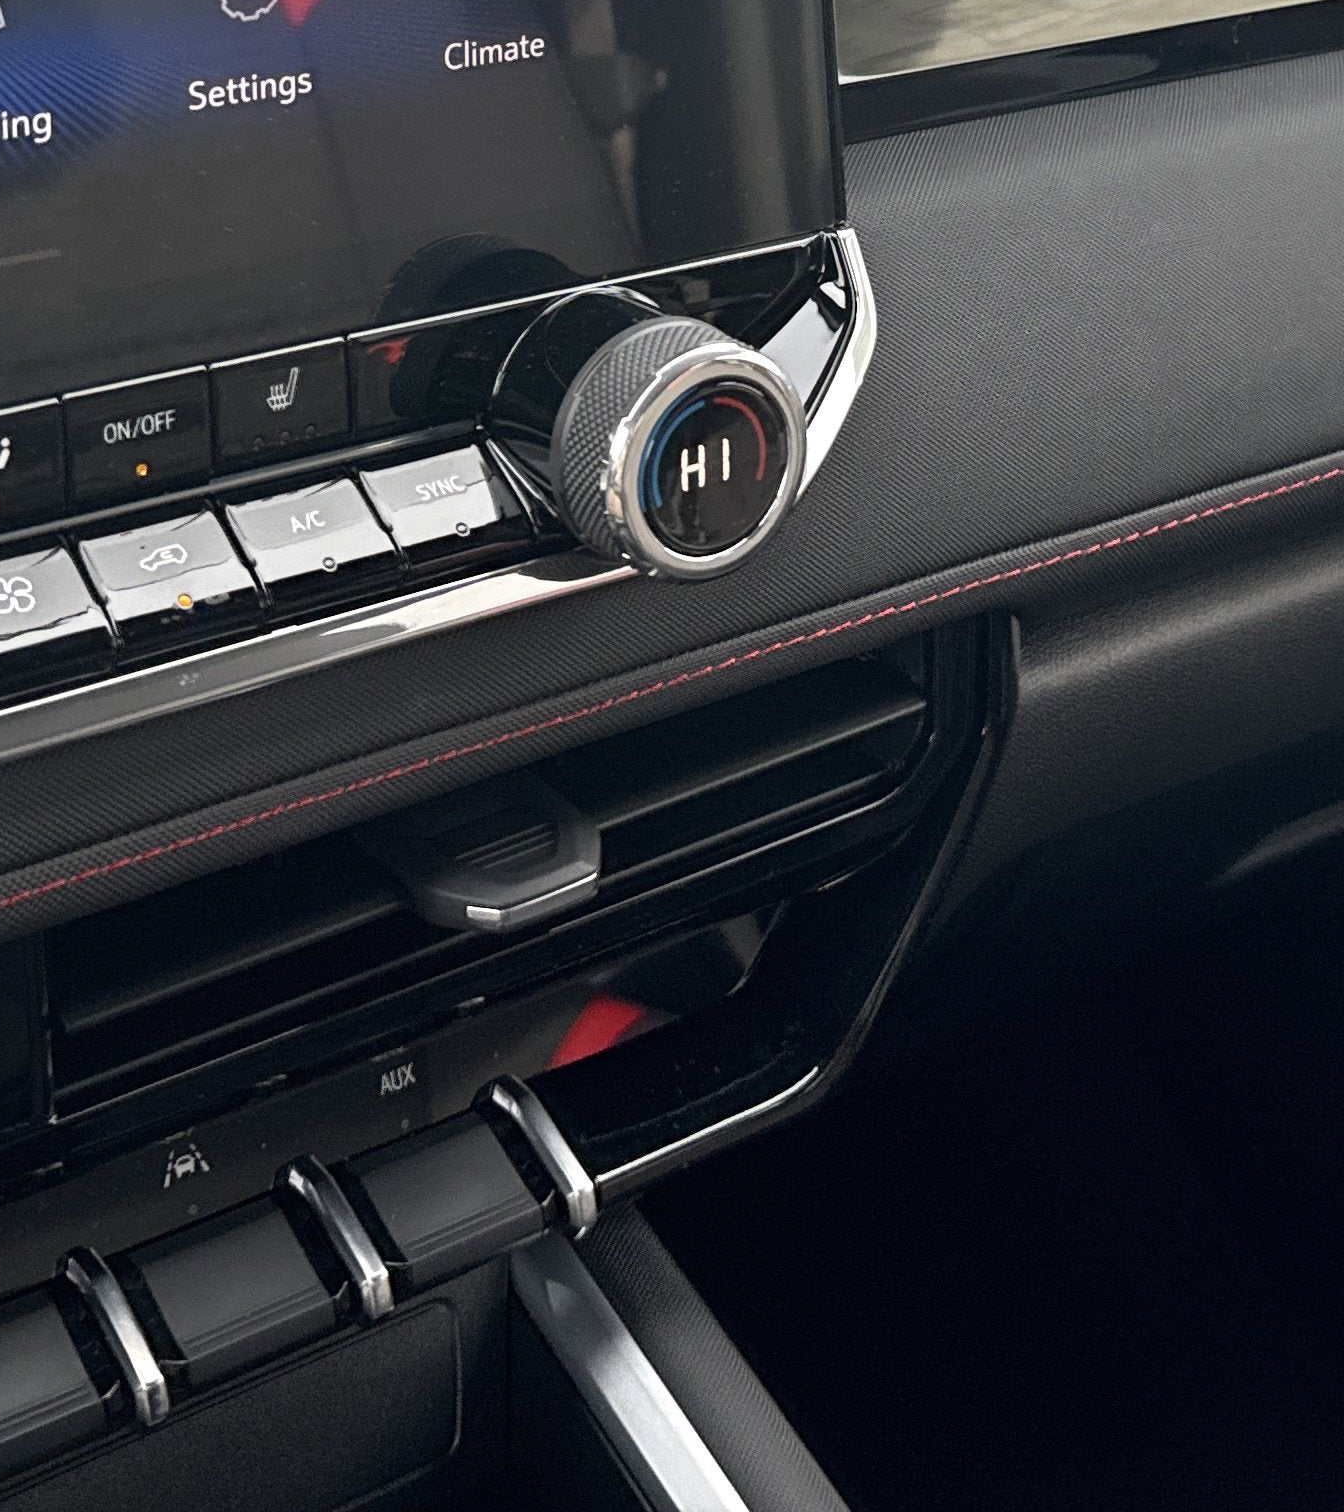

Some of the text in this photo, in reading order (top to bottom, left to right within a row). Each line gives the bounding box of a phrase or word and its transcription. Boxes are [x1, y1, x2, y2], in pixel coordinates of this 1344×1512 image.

[443, 33, 546, 72] Climate
[187, 68, 314, 112] Settings
[103, 408, 176, 445] ON/OFF
[679, 436, 731, 493] HI
[416, 475, 467, 501] SYNC
[289, 509, 327, 534] A/C
[380, 1061, 416, 1096] AUX
